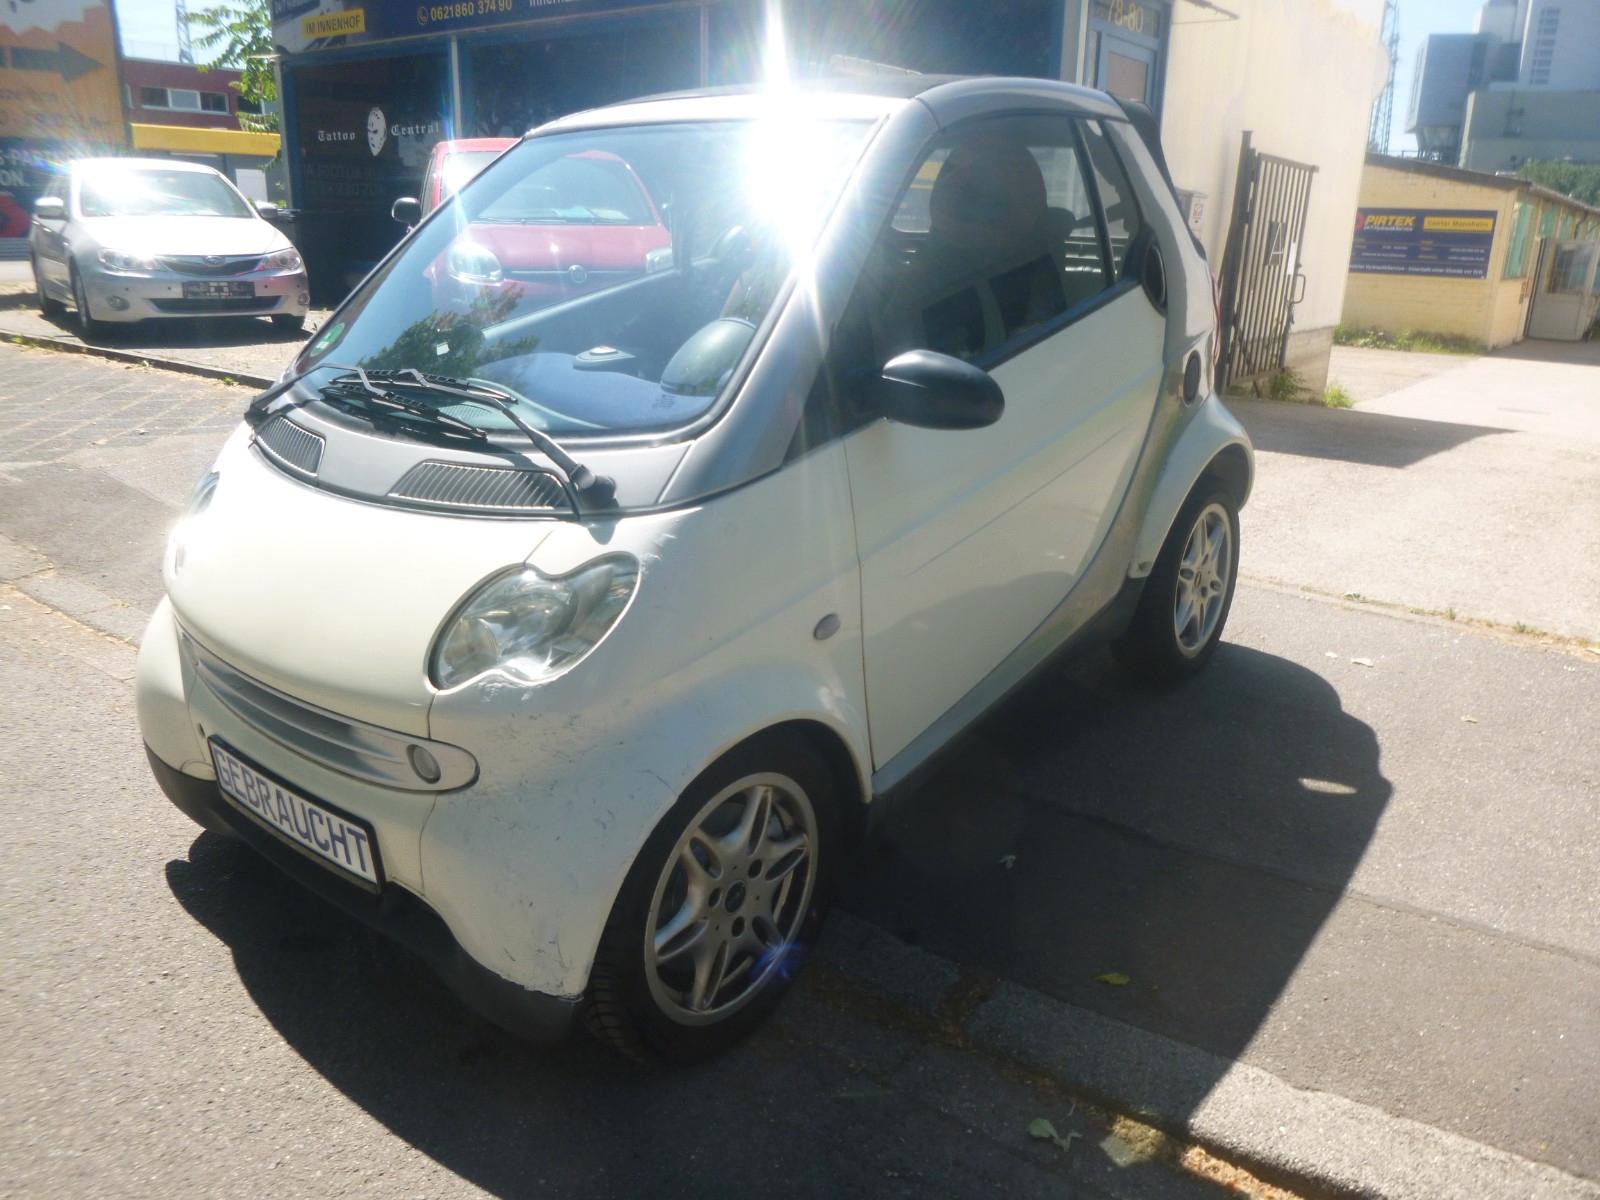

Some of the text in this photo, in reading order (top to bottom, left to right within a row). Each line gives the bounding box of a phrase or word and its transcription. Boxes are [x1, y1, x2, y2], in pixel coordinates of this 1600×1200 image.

[317, 15, 361, 33] INNENHOF
[318, 121, 439, 142] Tattoo Central
[1364, 215, 1415, 226] PIRTEK
[212, 747, 367, 873] GEBRAUCHT
